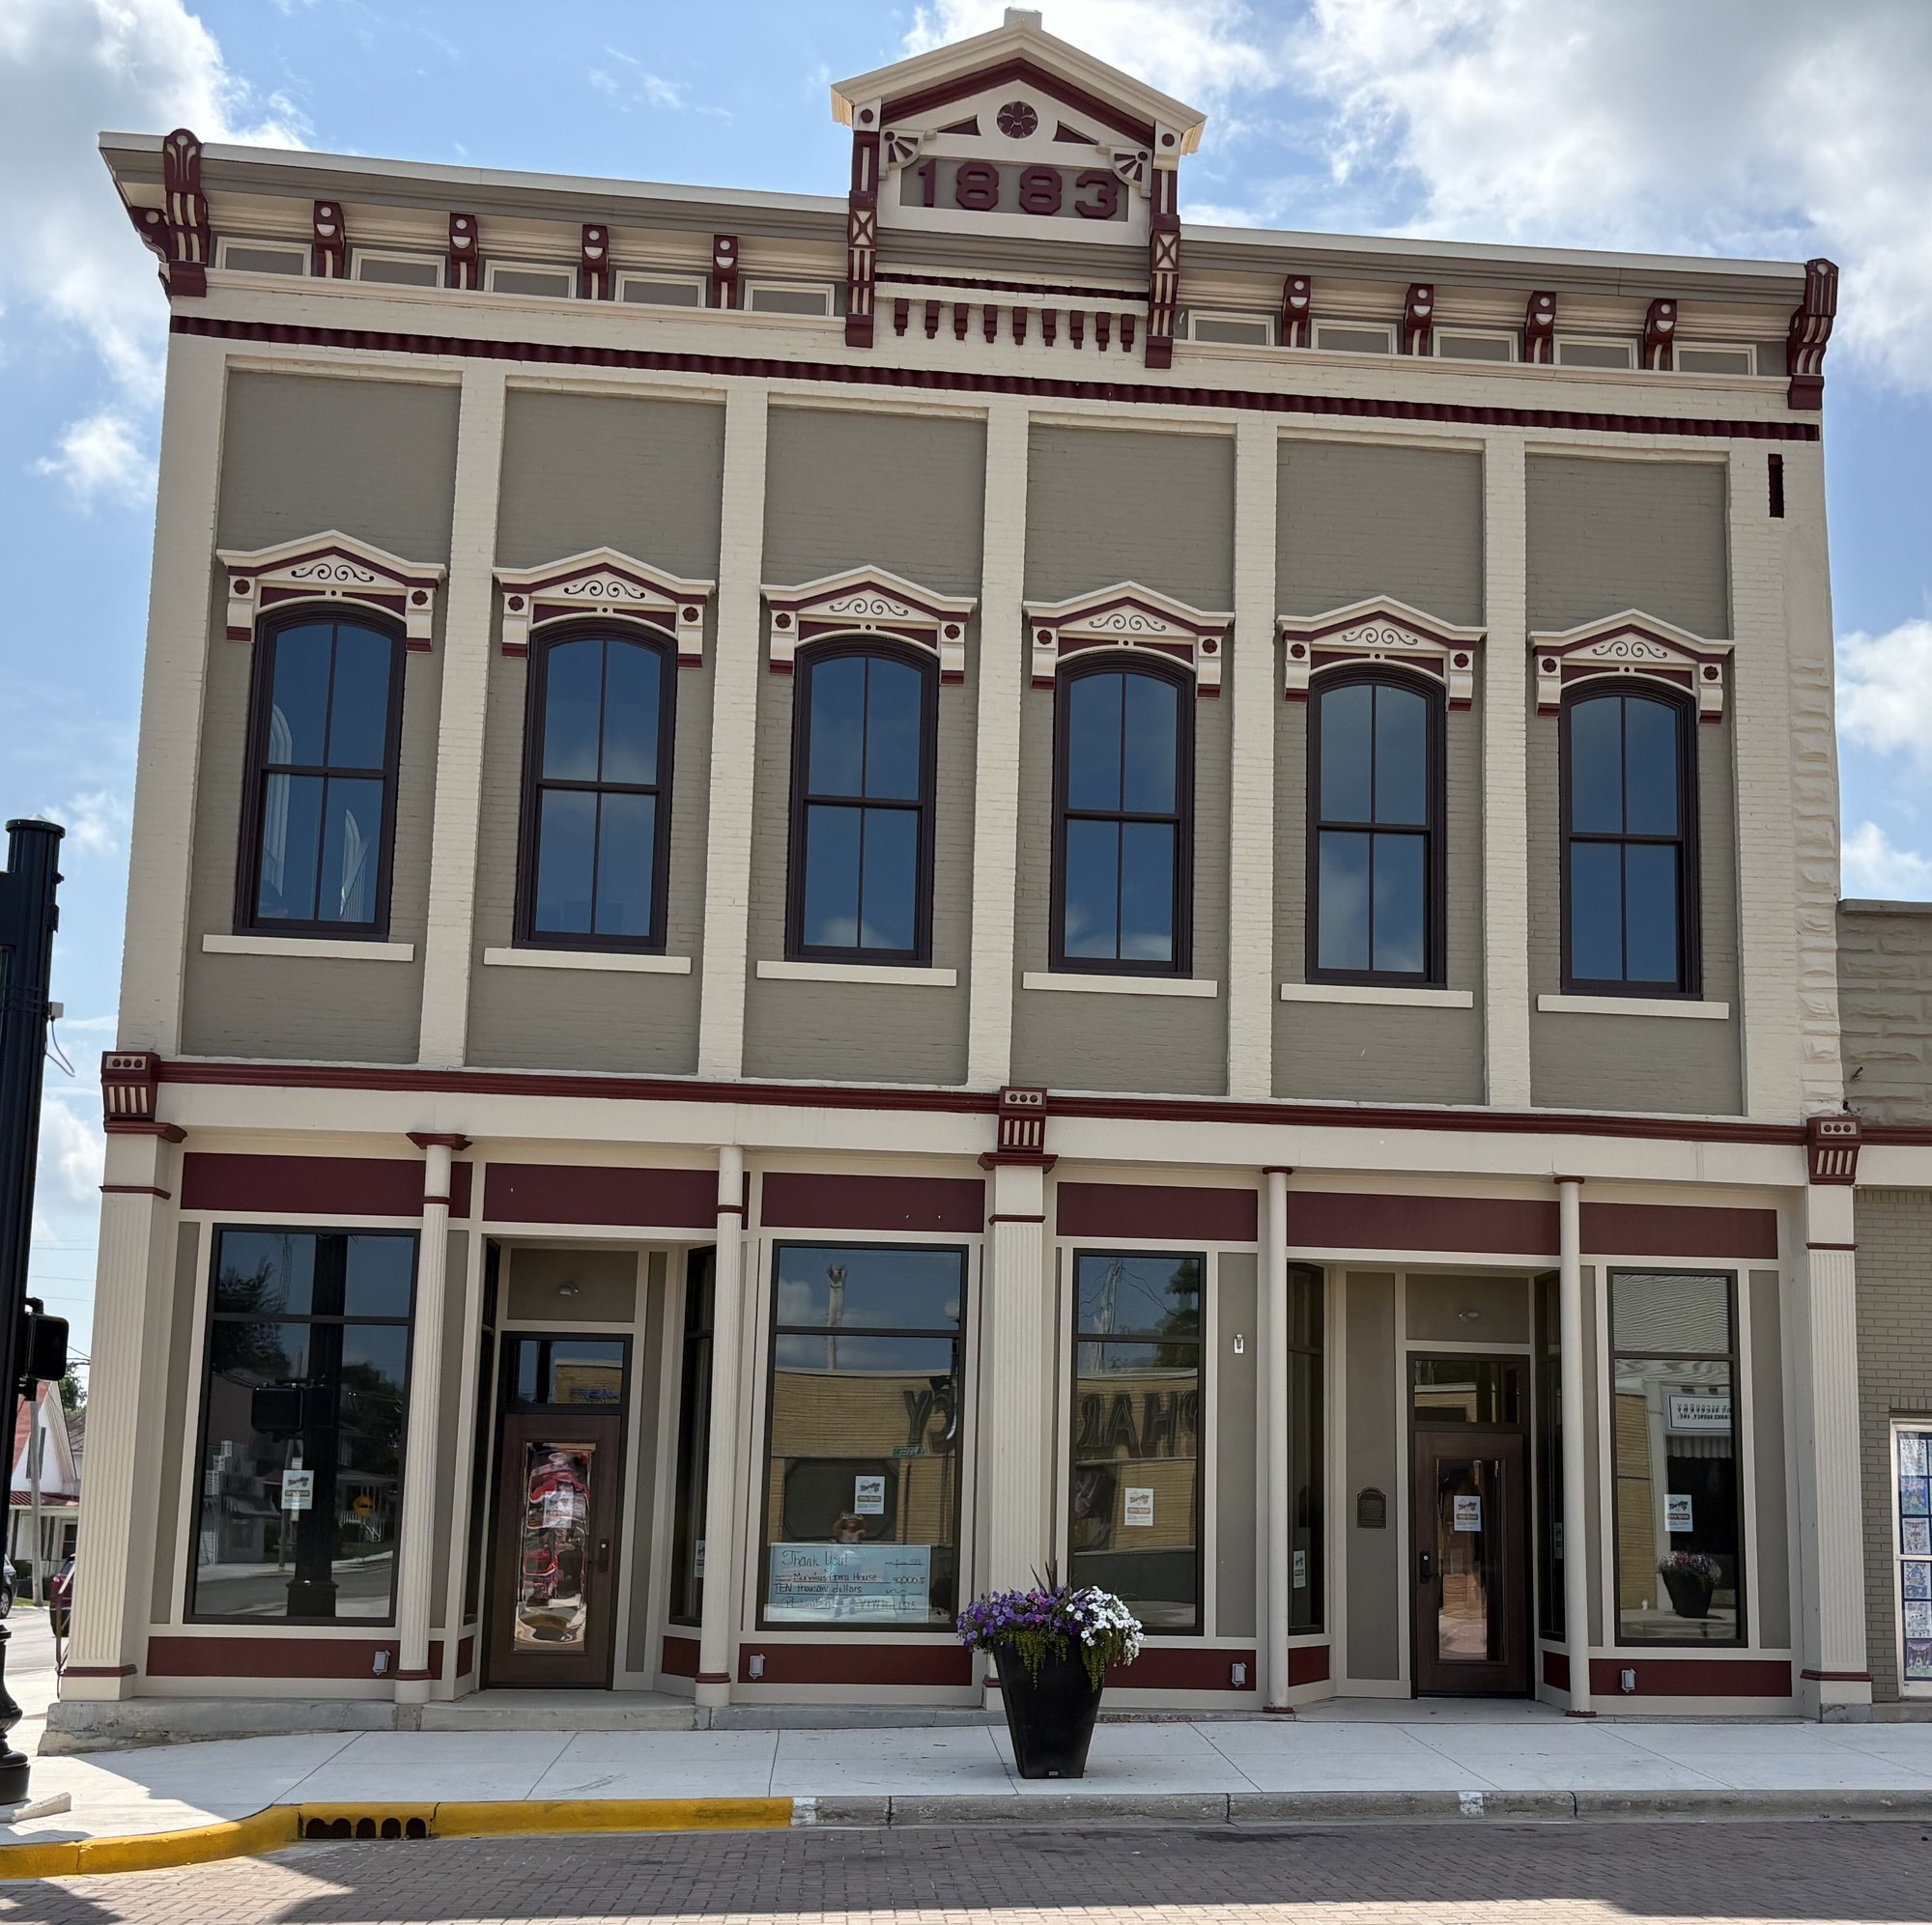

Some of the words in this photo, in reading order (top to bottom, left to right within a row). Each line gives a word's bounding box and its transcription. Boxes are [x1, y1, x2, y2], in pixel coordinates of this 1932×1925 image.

[918, 157, 1119, 219] 1883
[781, 1549, 820, 1568] Thank
[824, 1550, 849, 1572] You!
[852, 1572, 878, 1582] House
[774, 1583, 793, 1594] TEN
[832, 1583, 863, 1594] dollars
